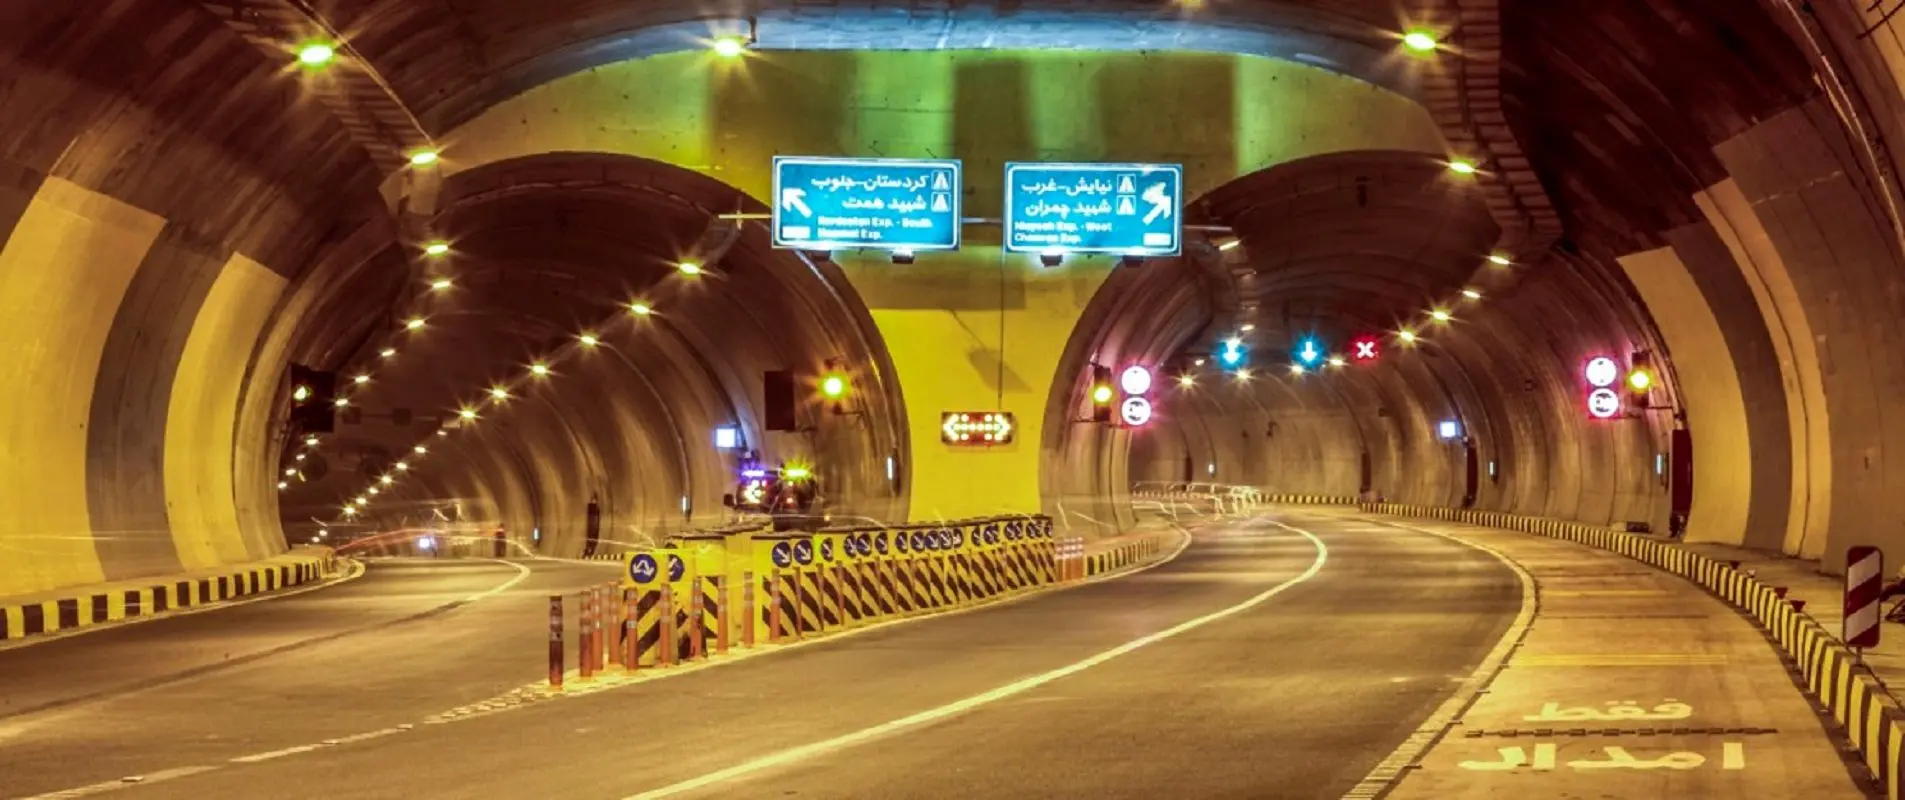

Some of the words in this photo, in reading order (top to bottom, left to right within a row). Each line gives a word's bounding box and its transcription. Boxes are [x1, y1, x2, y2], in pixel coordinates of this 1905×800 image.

[888, 194, 927, 213] شهید
[1025, 199, 1071, 220] چمران
[1073, 199, 1112, 217] شهید
[1522, 698, 1693, 721] فقط
[1457, 742, 1746, 770] امداد
